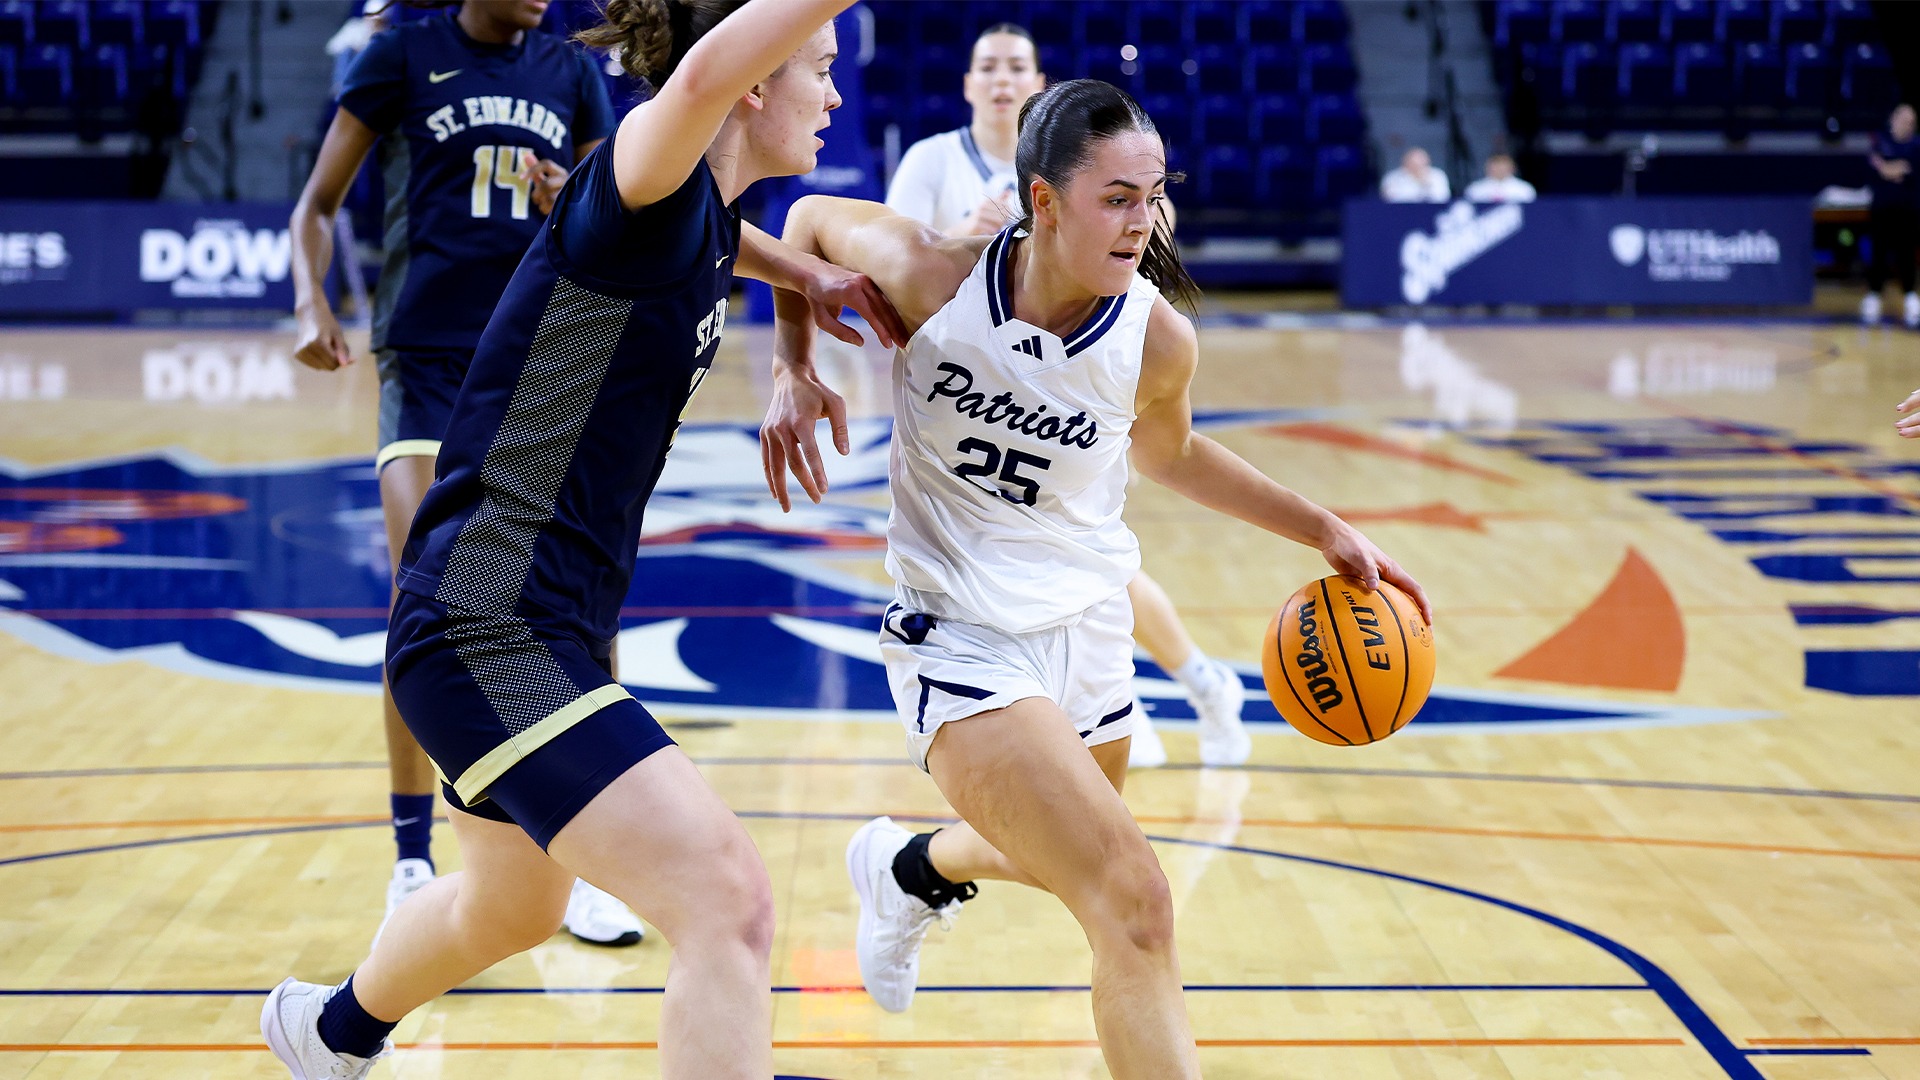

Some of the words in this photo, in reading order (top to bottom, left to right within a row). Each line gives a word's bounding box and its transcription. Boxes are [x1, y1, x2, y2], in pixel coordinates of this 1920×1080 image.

[426, 104, 466, 143] ST.
[471, 145, 534, 220] 14
[139, 228, 291, 283] DOW
[927, 361, 1098, 450] Patriots
[954, 436, 1051, 507] 25
[1296, 596, 1344, 714] Wilson
[1351, 606, 1391, 671] EVO
